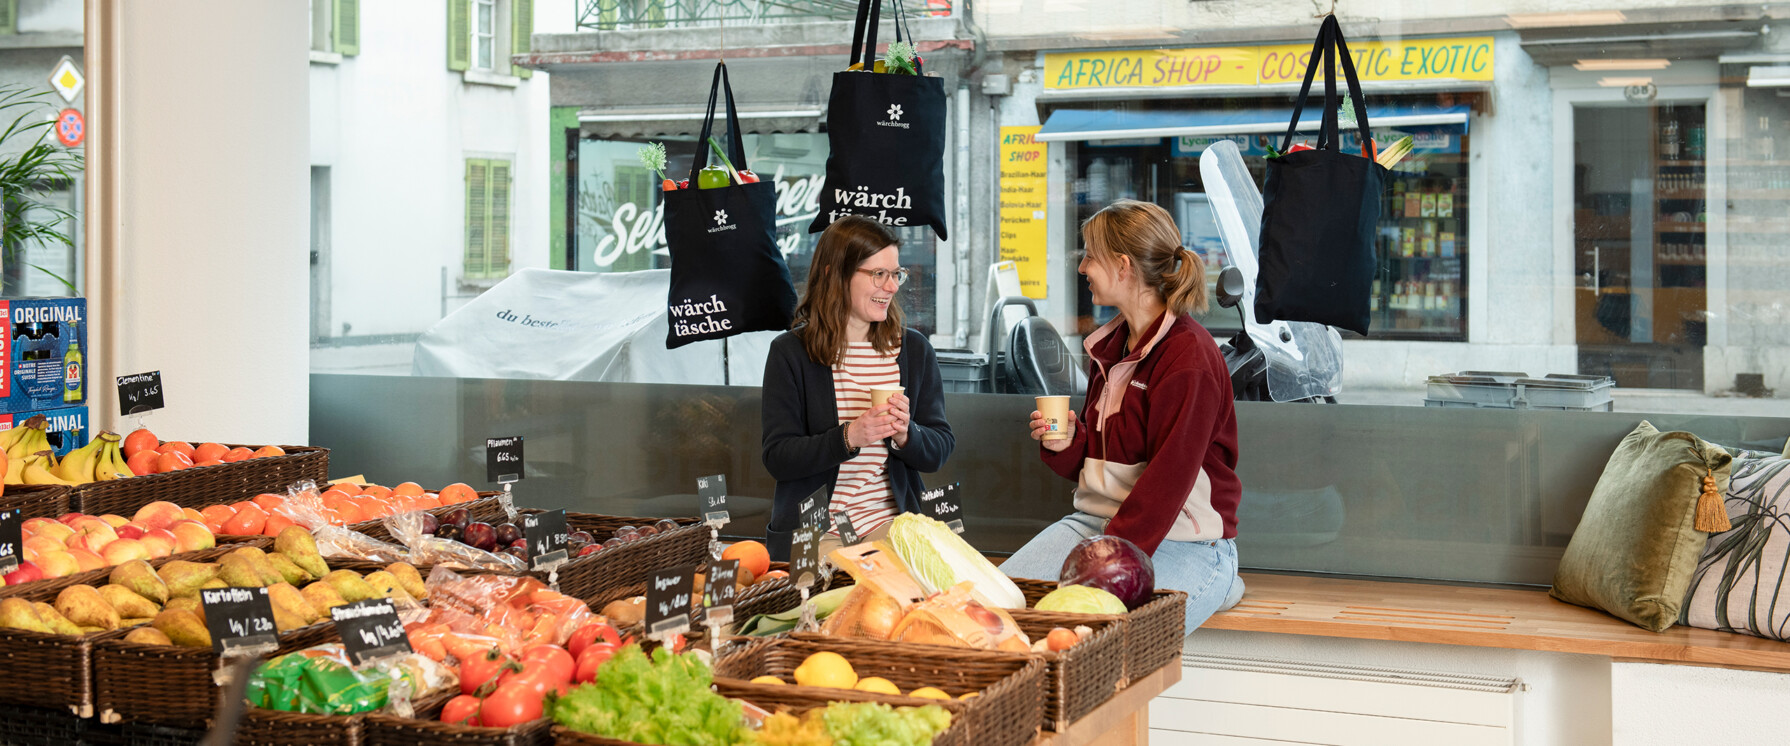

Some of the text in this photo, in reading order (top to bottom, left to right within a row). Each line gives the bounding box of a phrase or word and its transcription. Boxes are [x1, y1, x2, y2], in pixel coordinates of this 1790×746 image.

[1057, 57, 1143, 87] AFRICA
[1153, 55, 1222, 84] SHOP
[1400, 44, 1489, 75] EXOTIC
[876, 120, 910, 129] wärchbrogg
[1009, 150, 1040, 162] SHOP
[1000, 170, 1046, 178] Brazilian-Haar
[834, 186, 912, 210] wärch
[1000, 216, 1031, 225] Perücken
[707, 223, 737, 234] wärchbrogg
[1001, 231, 1016, 240] Clips
[669, 294, 728, 318] wärch
[15, 305, 82, 324] ORIGINAL
[496, 309, 518, 323] du
[674, 315, 733, 337] täsche
[117, 373, 153, 387] Clementine
[800, 497, 815, 514] Lauch
[203, 588, 254, 605] Kartoffeln
